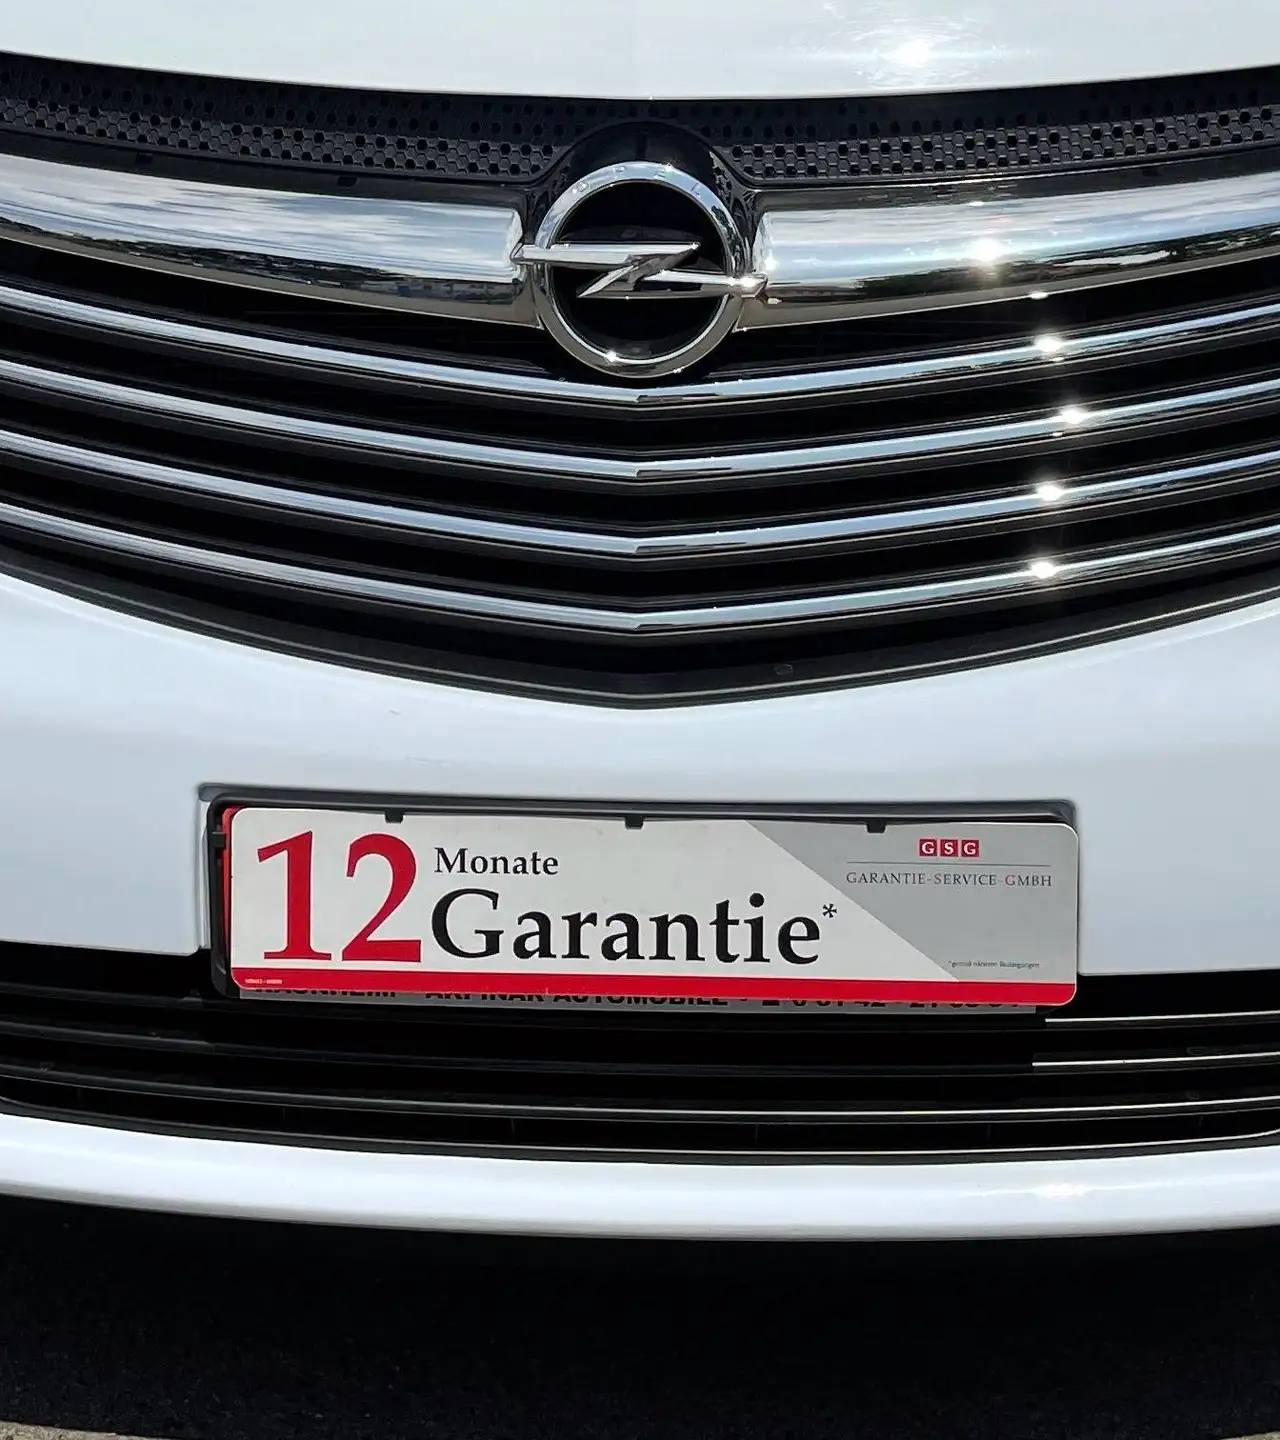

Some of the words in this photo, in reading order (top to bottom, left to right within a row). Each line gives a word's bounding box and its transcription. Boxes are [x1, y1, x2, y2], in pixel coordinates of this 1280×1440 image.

[920, 841, 978, 856] GSG
[257, 830, 421, 963] 12
[434, 847, 558, 875] Monate
